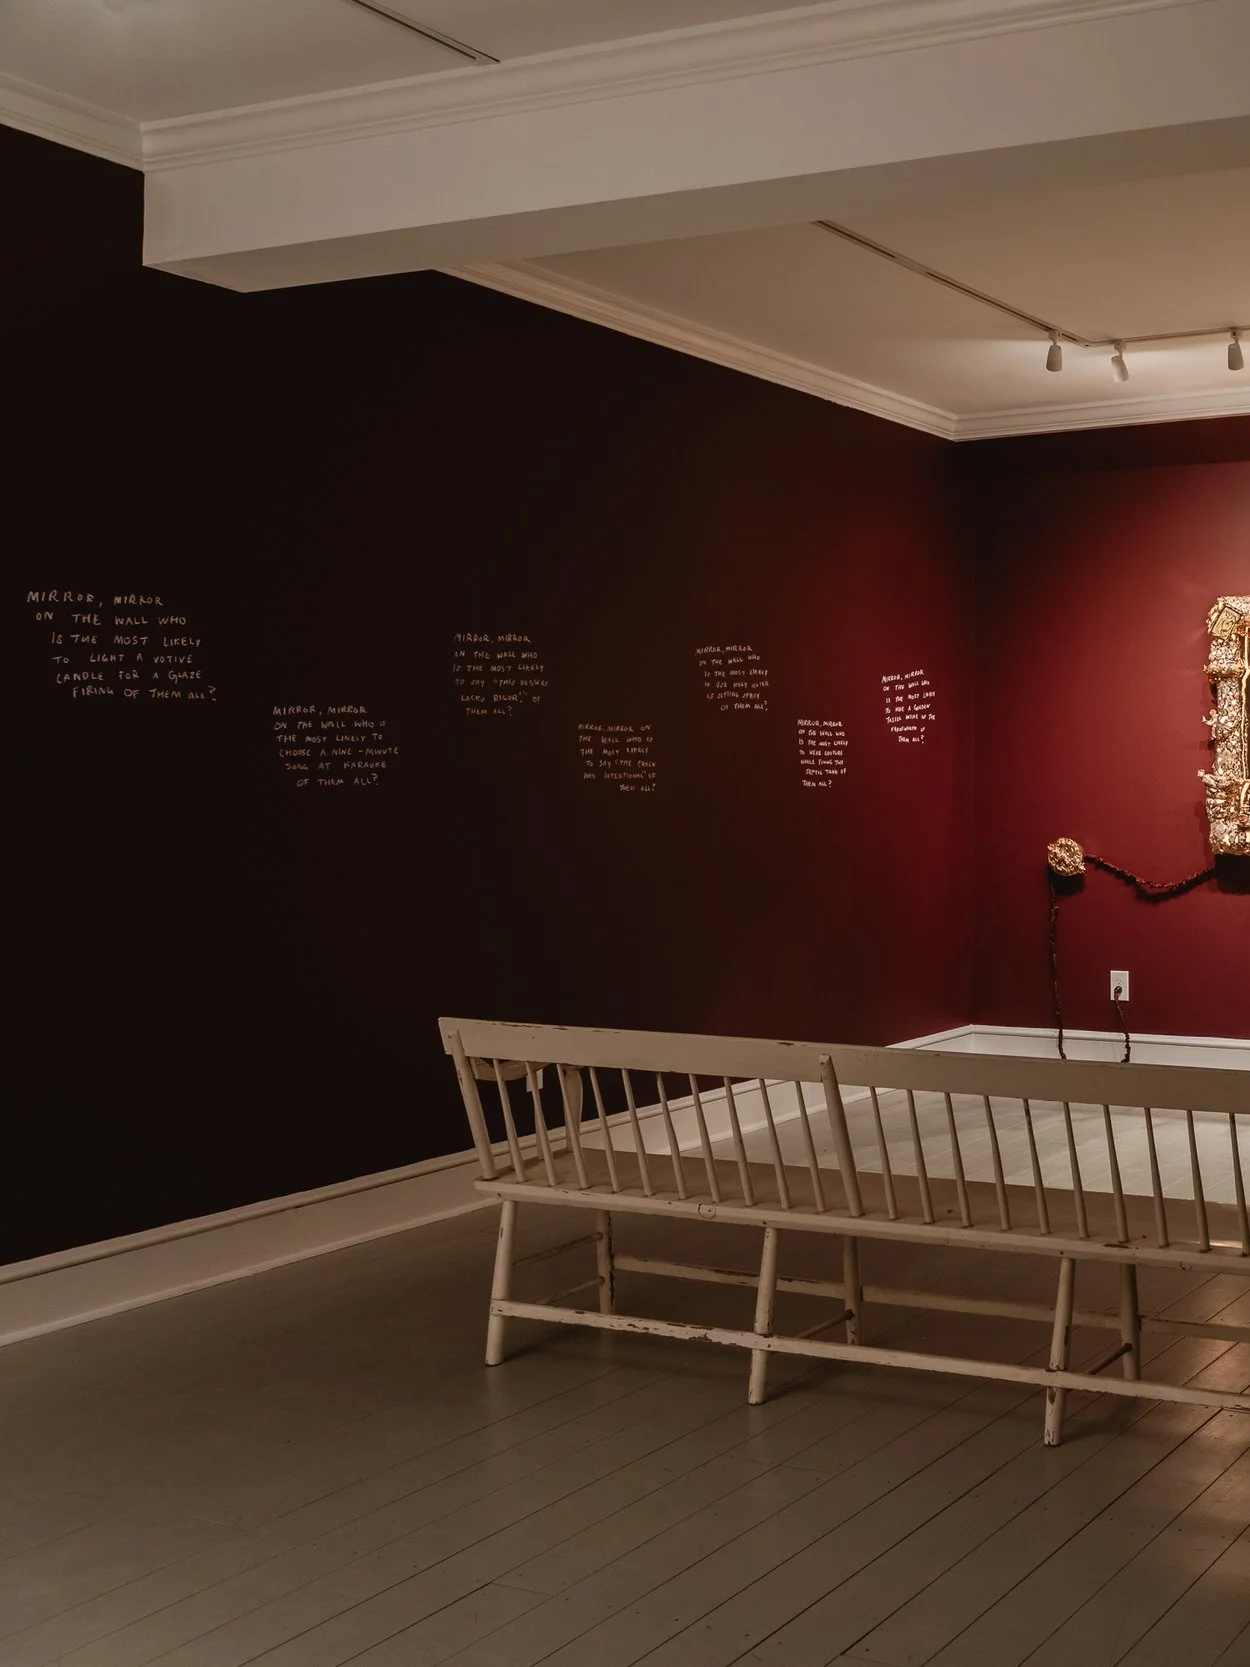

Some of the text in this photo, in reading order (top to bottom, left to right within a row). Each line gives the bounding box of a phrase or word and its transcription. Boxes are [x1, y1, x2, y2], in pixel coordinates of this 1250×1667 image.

[27, 590, 163, 607] MIRROR, MIRROR
[36, 612, 186, 625] ON THE WALL WHO
[52, 632, 201, 646] IS THE MOST LIKELY
[453, 633, 531, 644] MIRROR, MIRROR
[473, 651, 490, 659] THE
[497, 651, 516, 659] WALL
[695, 646, 724, 656] MIRROR,
[52, 653, 192, 664] TO LIGHT A VOTIVE
[453, 663, 461, 672] IS
[466, 664, 483, 672] THE
[517, 664, 544, 672] LIKELY
[57, 672, 103, 683] CANDLE
[119, 670, 139, 679] FOR
[168, 670, 201, 684] GLAZE
[904, 669, 924, 679] MIRROR
[471, 679, 485, 687] SAY
[72, 685, 216, 700] FIRING OF THEM ALL?
[461, 694, 485, 702] LACKS
[273, 705, 367, 716] MIRROR, MIRROR
[465, 705, 513, 717] THEM ALL?
[754, 701, 767, 711] ALL?
[273, 721, 287, 730] ON
[297, 721, 312, 729] THE
[321, 721, 346, 729] WALL
[354, 720, 374, 728] WHO
[276, 734, 297, 743] THE
[601, 736, 619, 744] WALL
[279, 749, 311, 757] CHOOSE
[580, 748, 593, 756] THE
[285, 761, 387, 770] SONG AT KARAOKE
[599, 760, 611, 768] SAY
[296, 778, 309, 787] OF
[353, 773, 378, 785] ALL?
[641, 783, 656, 791] ALL?
